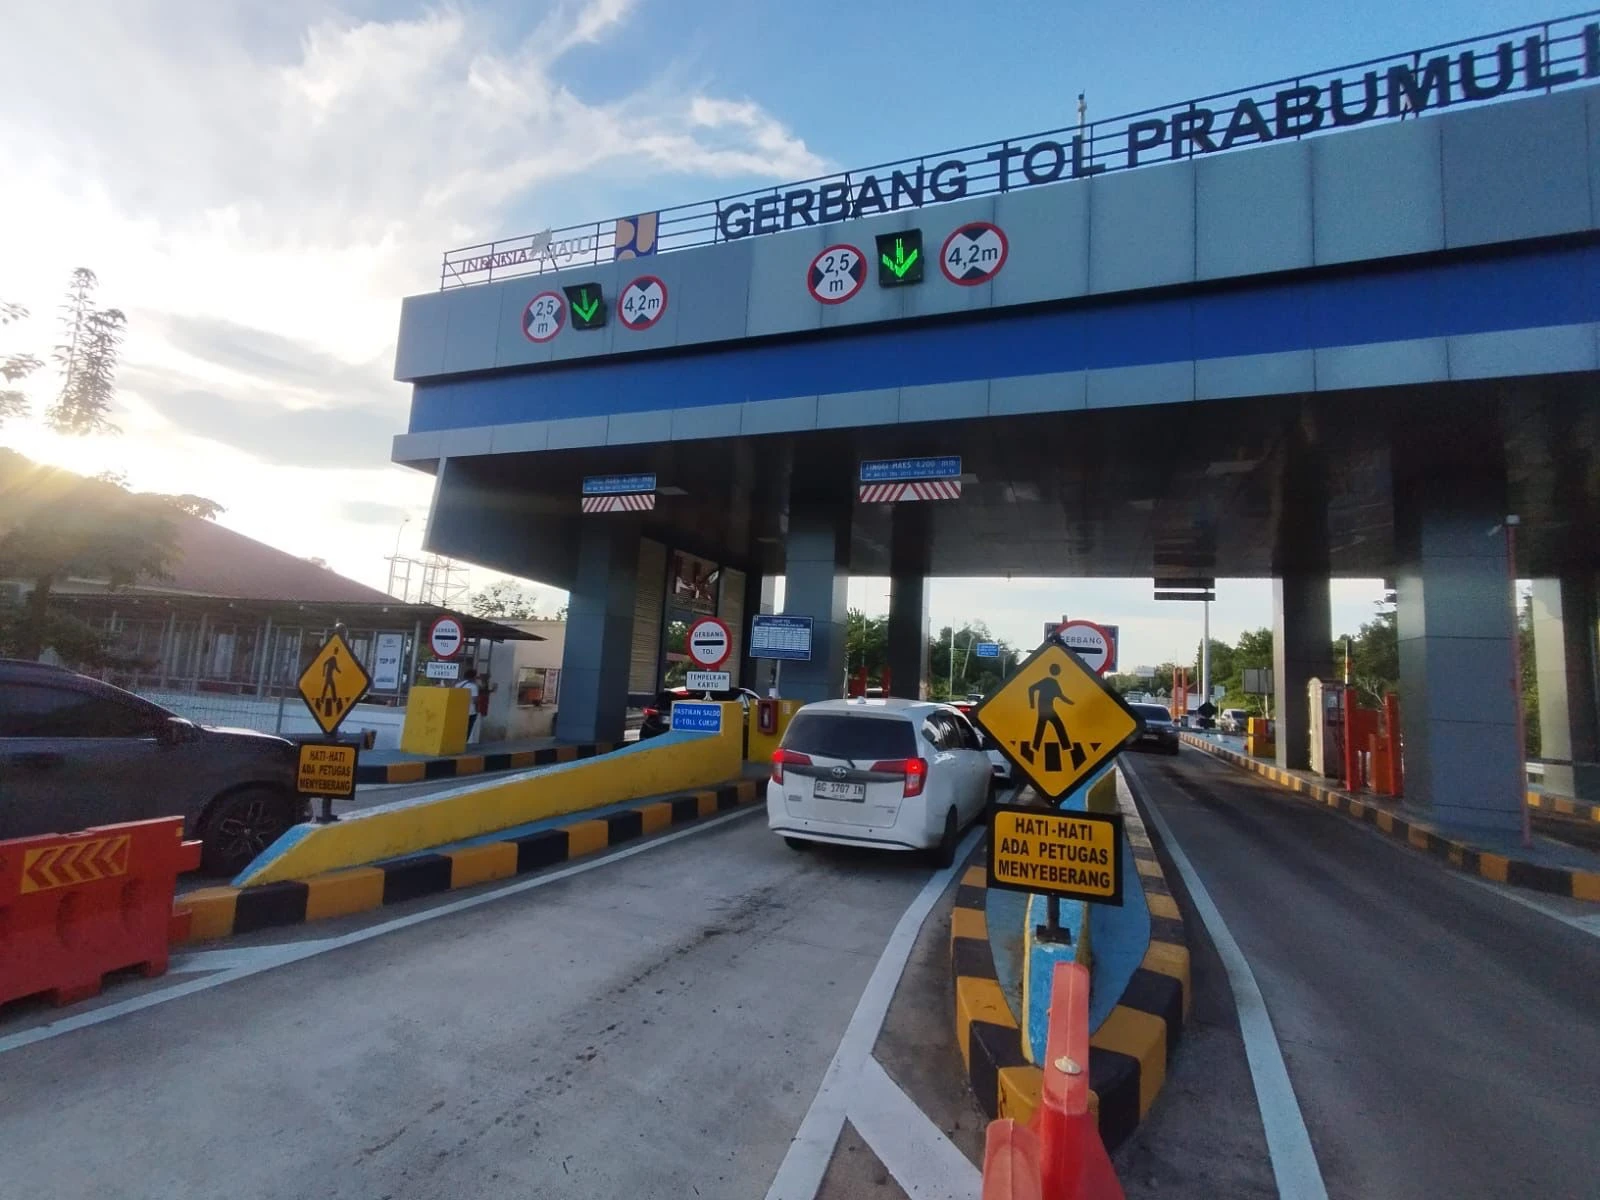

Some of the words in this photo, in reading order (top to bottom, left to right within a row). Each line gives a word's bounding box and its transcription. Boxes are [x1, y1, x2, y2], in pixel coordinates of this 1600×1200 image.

[720, 160, 967, 239] GERBANG
[987, 135, 1106, 193] TOL
[825, 253, 850, 276] 2,5
[828, 279, 844, 293] m
[536, 299, 554, 319] 2,5
[537, 321, 548, 333] m
[690, 673, 727, 681] TEMPELKAN
[674, 708, 701, 717] PASTIKAN
[702, 709, 720, 717] SALDO
[698, 718, 718, 727] CUKUP
[302, 763, 316, 774] ADA
[319, 764, 351, 776] PETUGAS
[299, 777, 350, 791] MENYEBERANG
[816, 782, 827, 792] BG
[831, 783, 850, 794] 1707
[853, 784, 864, 795] IN
[1001, 838, 1030, 857] ADA
[1039, 842, 1108, 865] PETUGAS
[998, 859, 1110, 889] MENYEBERANG
